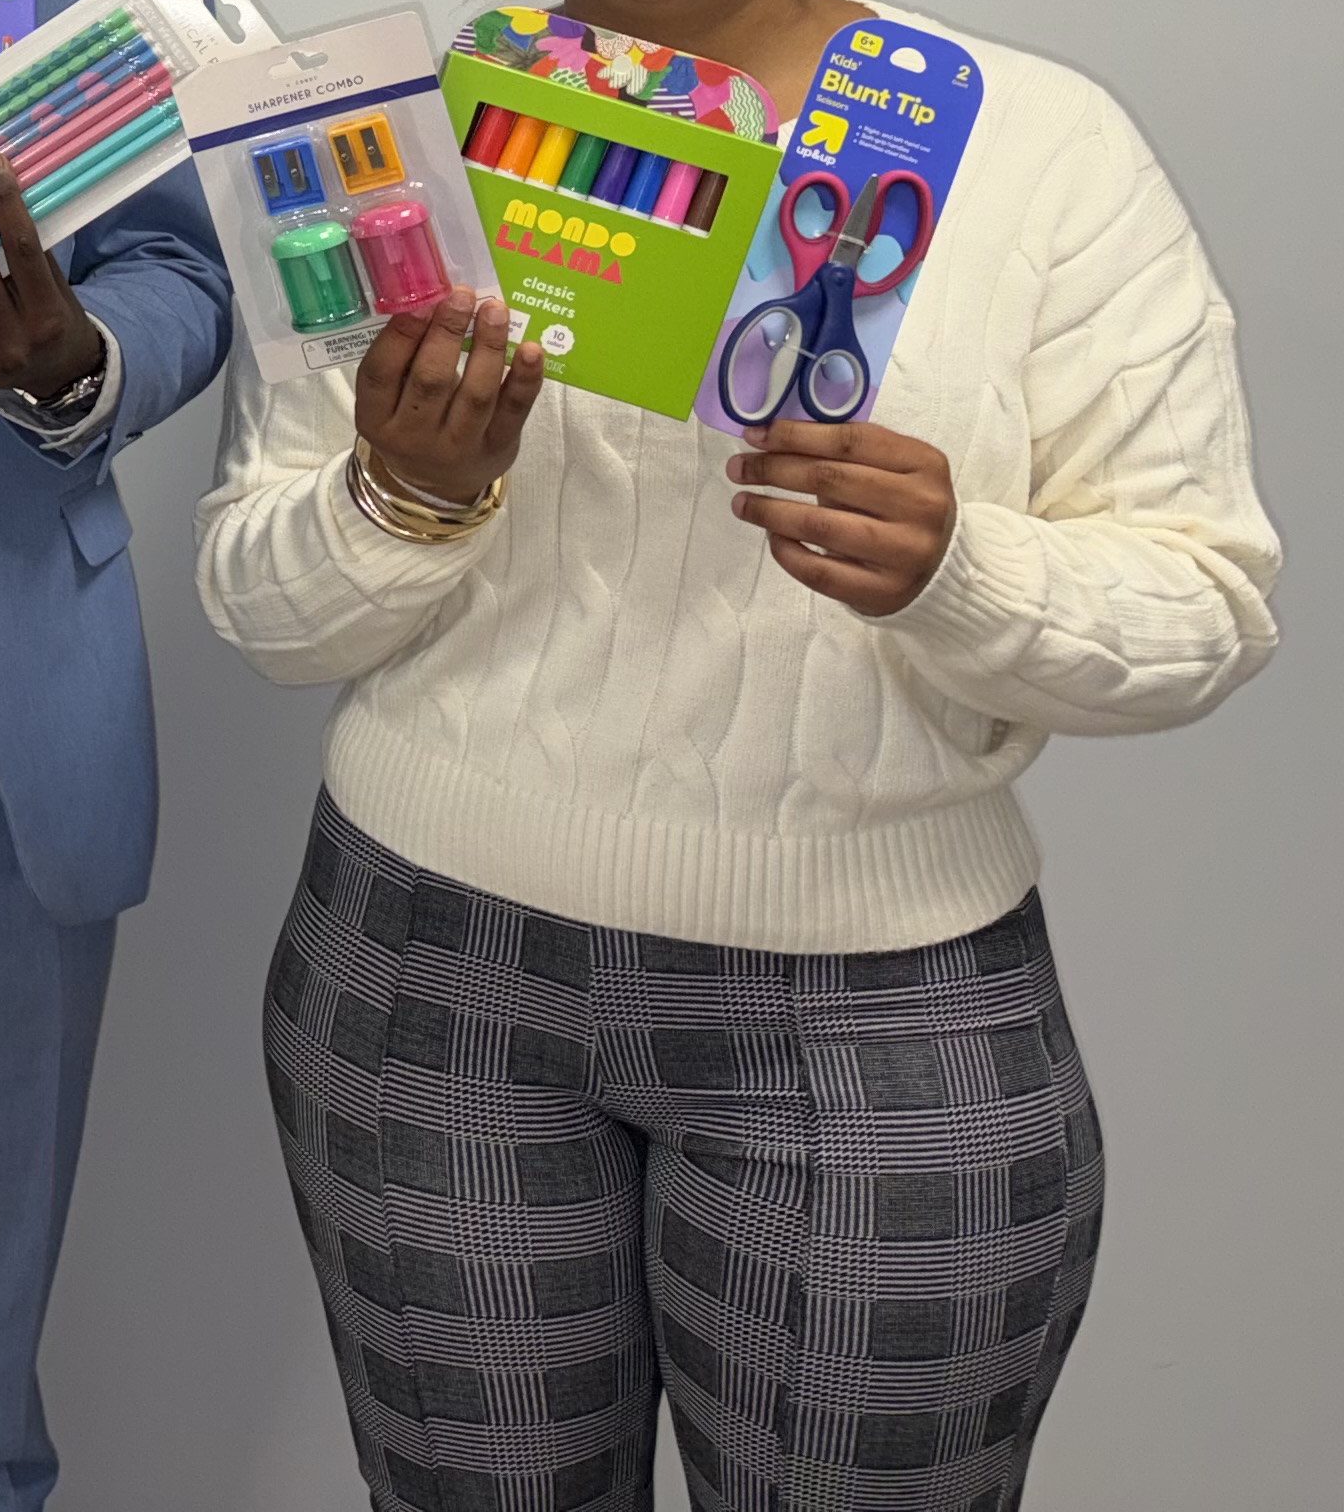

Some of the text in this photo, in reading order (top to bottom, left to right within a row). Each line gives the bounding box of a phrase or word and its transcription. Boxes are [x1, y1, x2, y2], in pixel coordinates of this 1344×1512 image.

[860, 35, 875, 47] 6+
[830, 52, 862, 71] Kids'
[956, 65, 971, 82] 2
[247, 88, 312, 114] SHARPENER
[315, 75, 364, 95] COMBO
[816, 94, 849, 112] Scissors
[820, 68, 936, 126] Blunt Tip
[796, 145, 837, 166] up&up
[502, 198, 637, 257] MONDO
[495, 223, 623, 285] LLAMA
[523, 276, 576, 301] classic
[512, 291, 576, 319] markers
[324, 329, 385, 348] WARNING: THI
[553, 330, 565, 341] 10
[326, 339, 372, 354] FUNCTION
